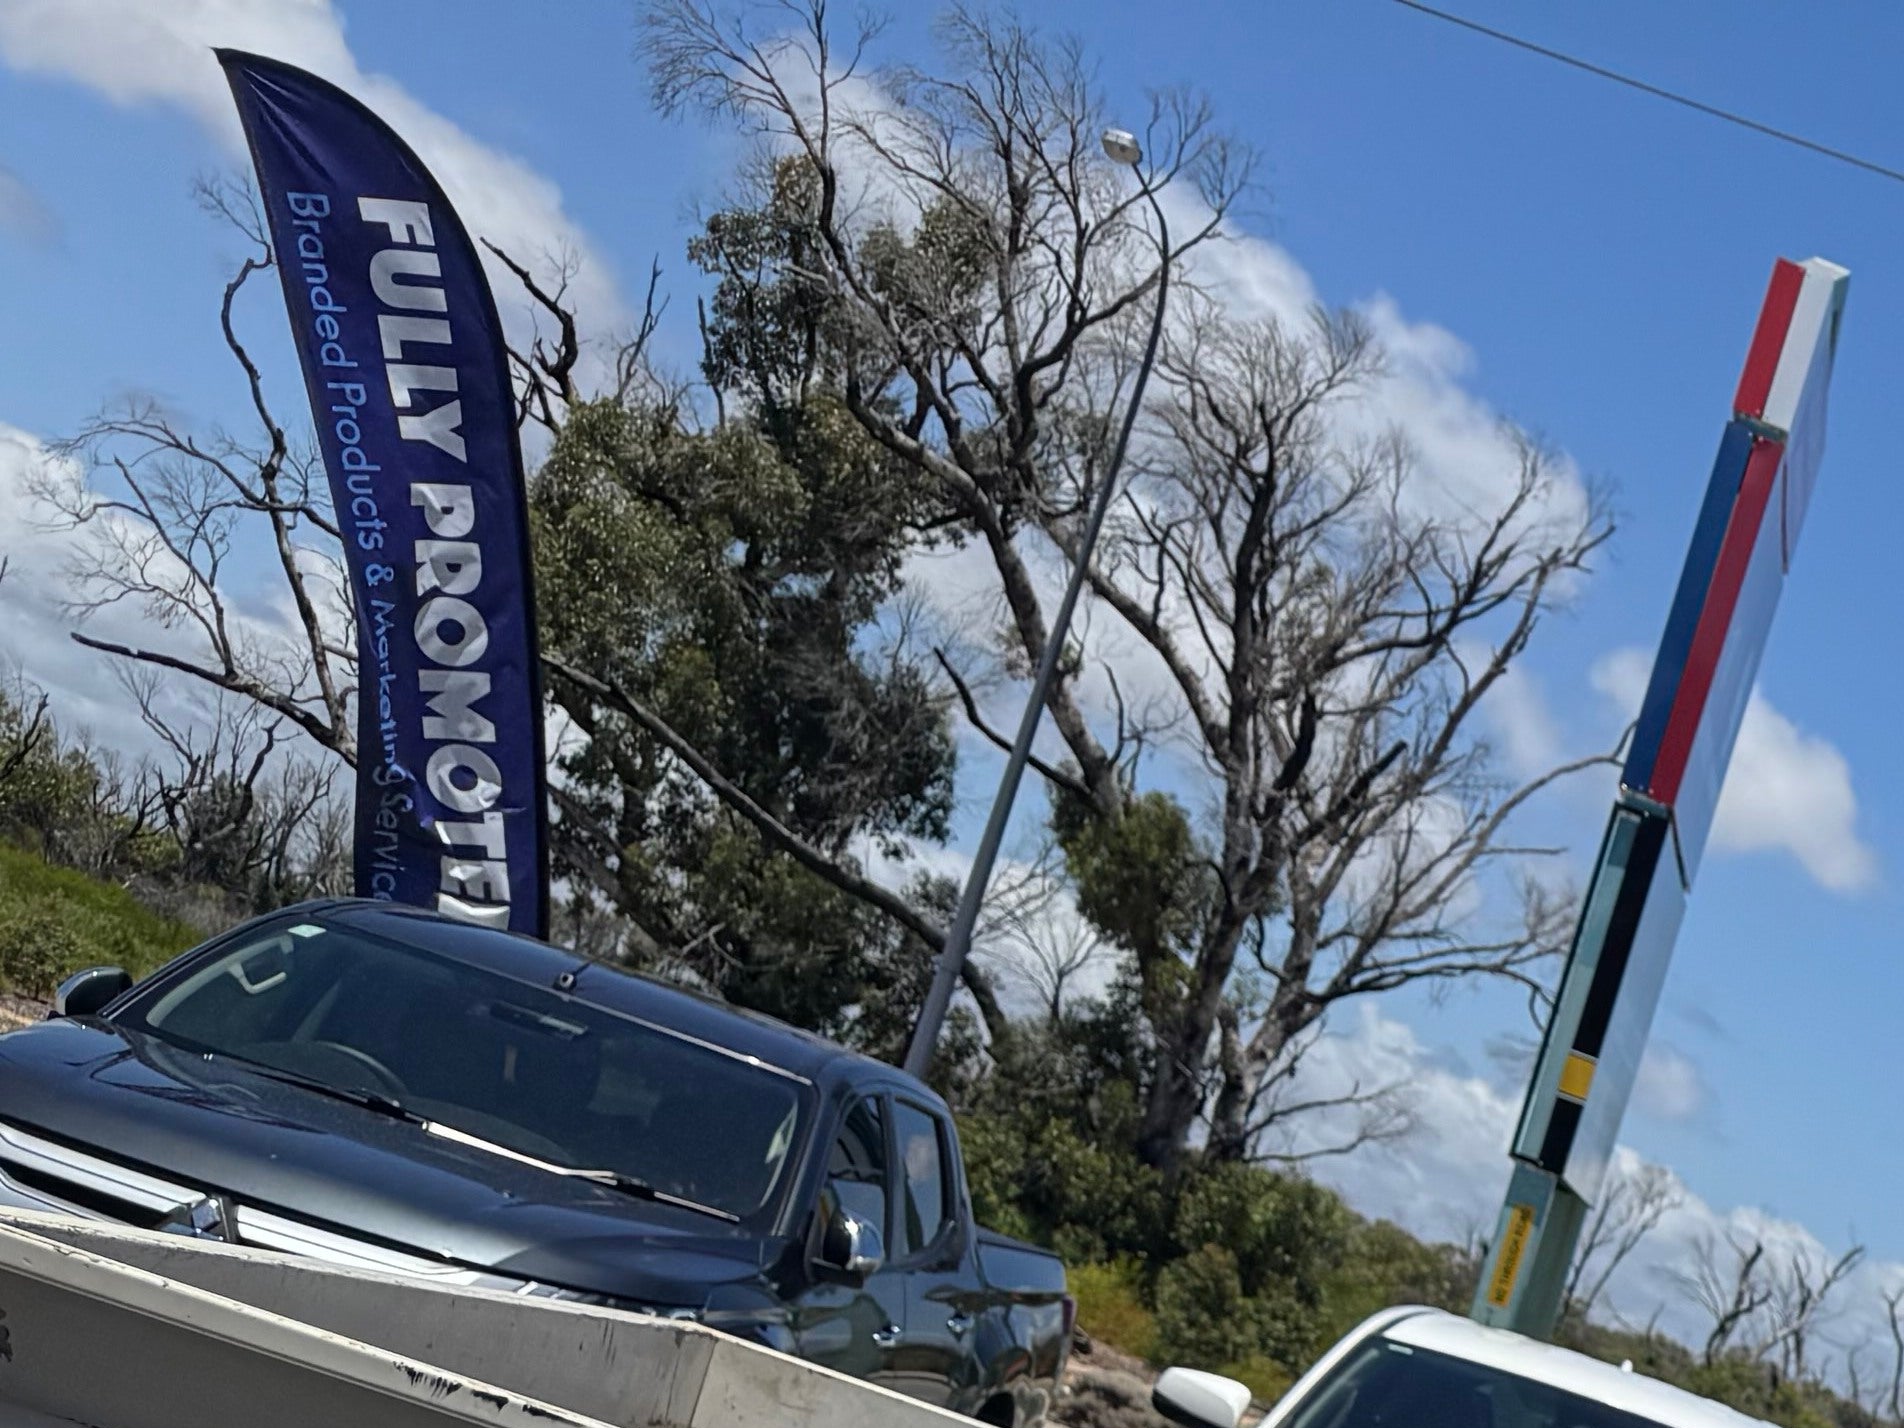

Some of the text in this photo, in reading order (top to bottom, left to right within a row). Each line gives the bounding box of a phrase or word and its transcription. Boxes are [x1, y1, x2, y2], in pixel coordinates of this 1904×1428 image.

[286, 191, 359, 368] Branded
[357, 196, 468, 464] FULLY
[327, 382, 388, 551] Products
[365, 563, 396, 588] &
[370, 599, 414, 787] Marketing
